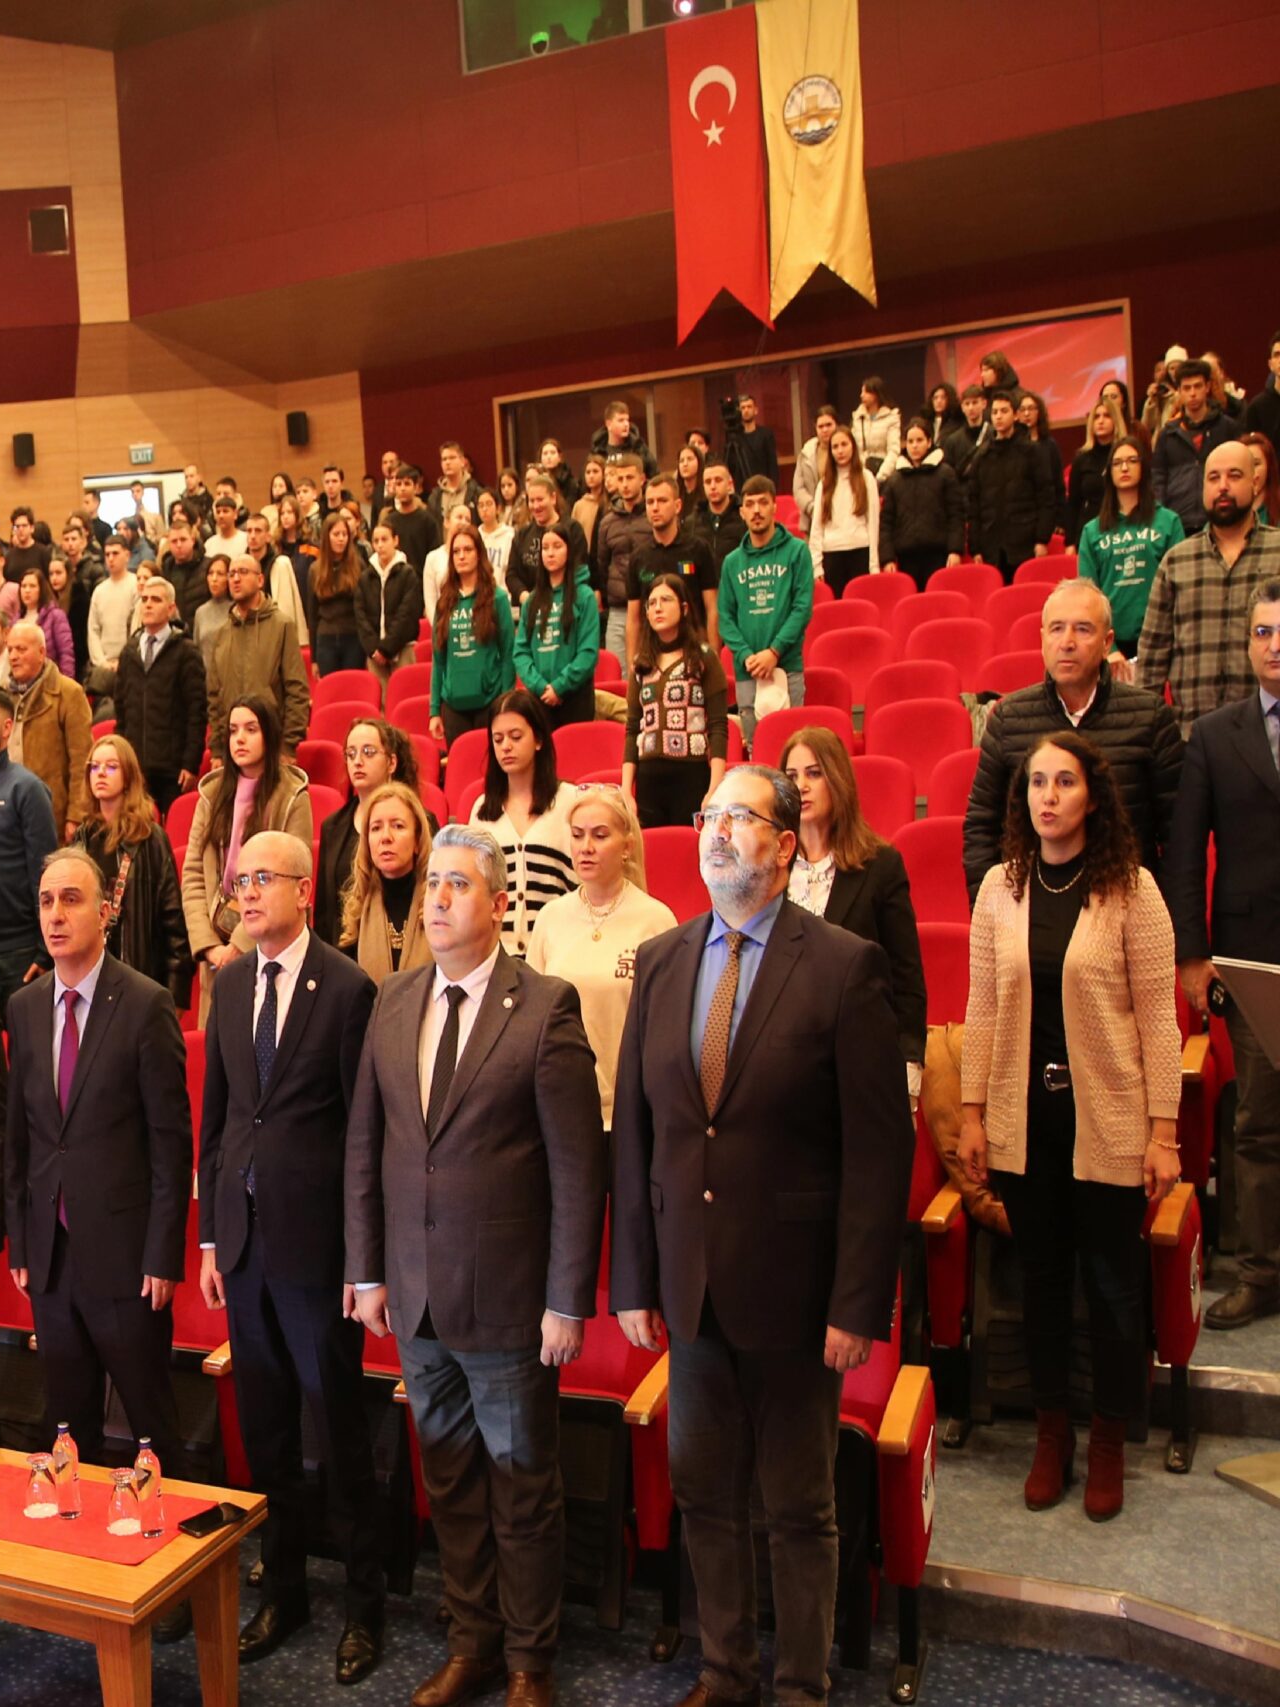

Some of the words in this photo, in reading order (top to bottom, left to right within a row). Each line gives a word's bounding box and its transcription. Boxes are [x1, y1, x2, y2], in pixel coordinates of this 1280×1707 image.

[131, 449, 152, 463] EXIT
[1099, 527, 1161, 550] USAMV
[737, 563, 788, 585] USAMV
